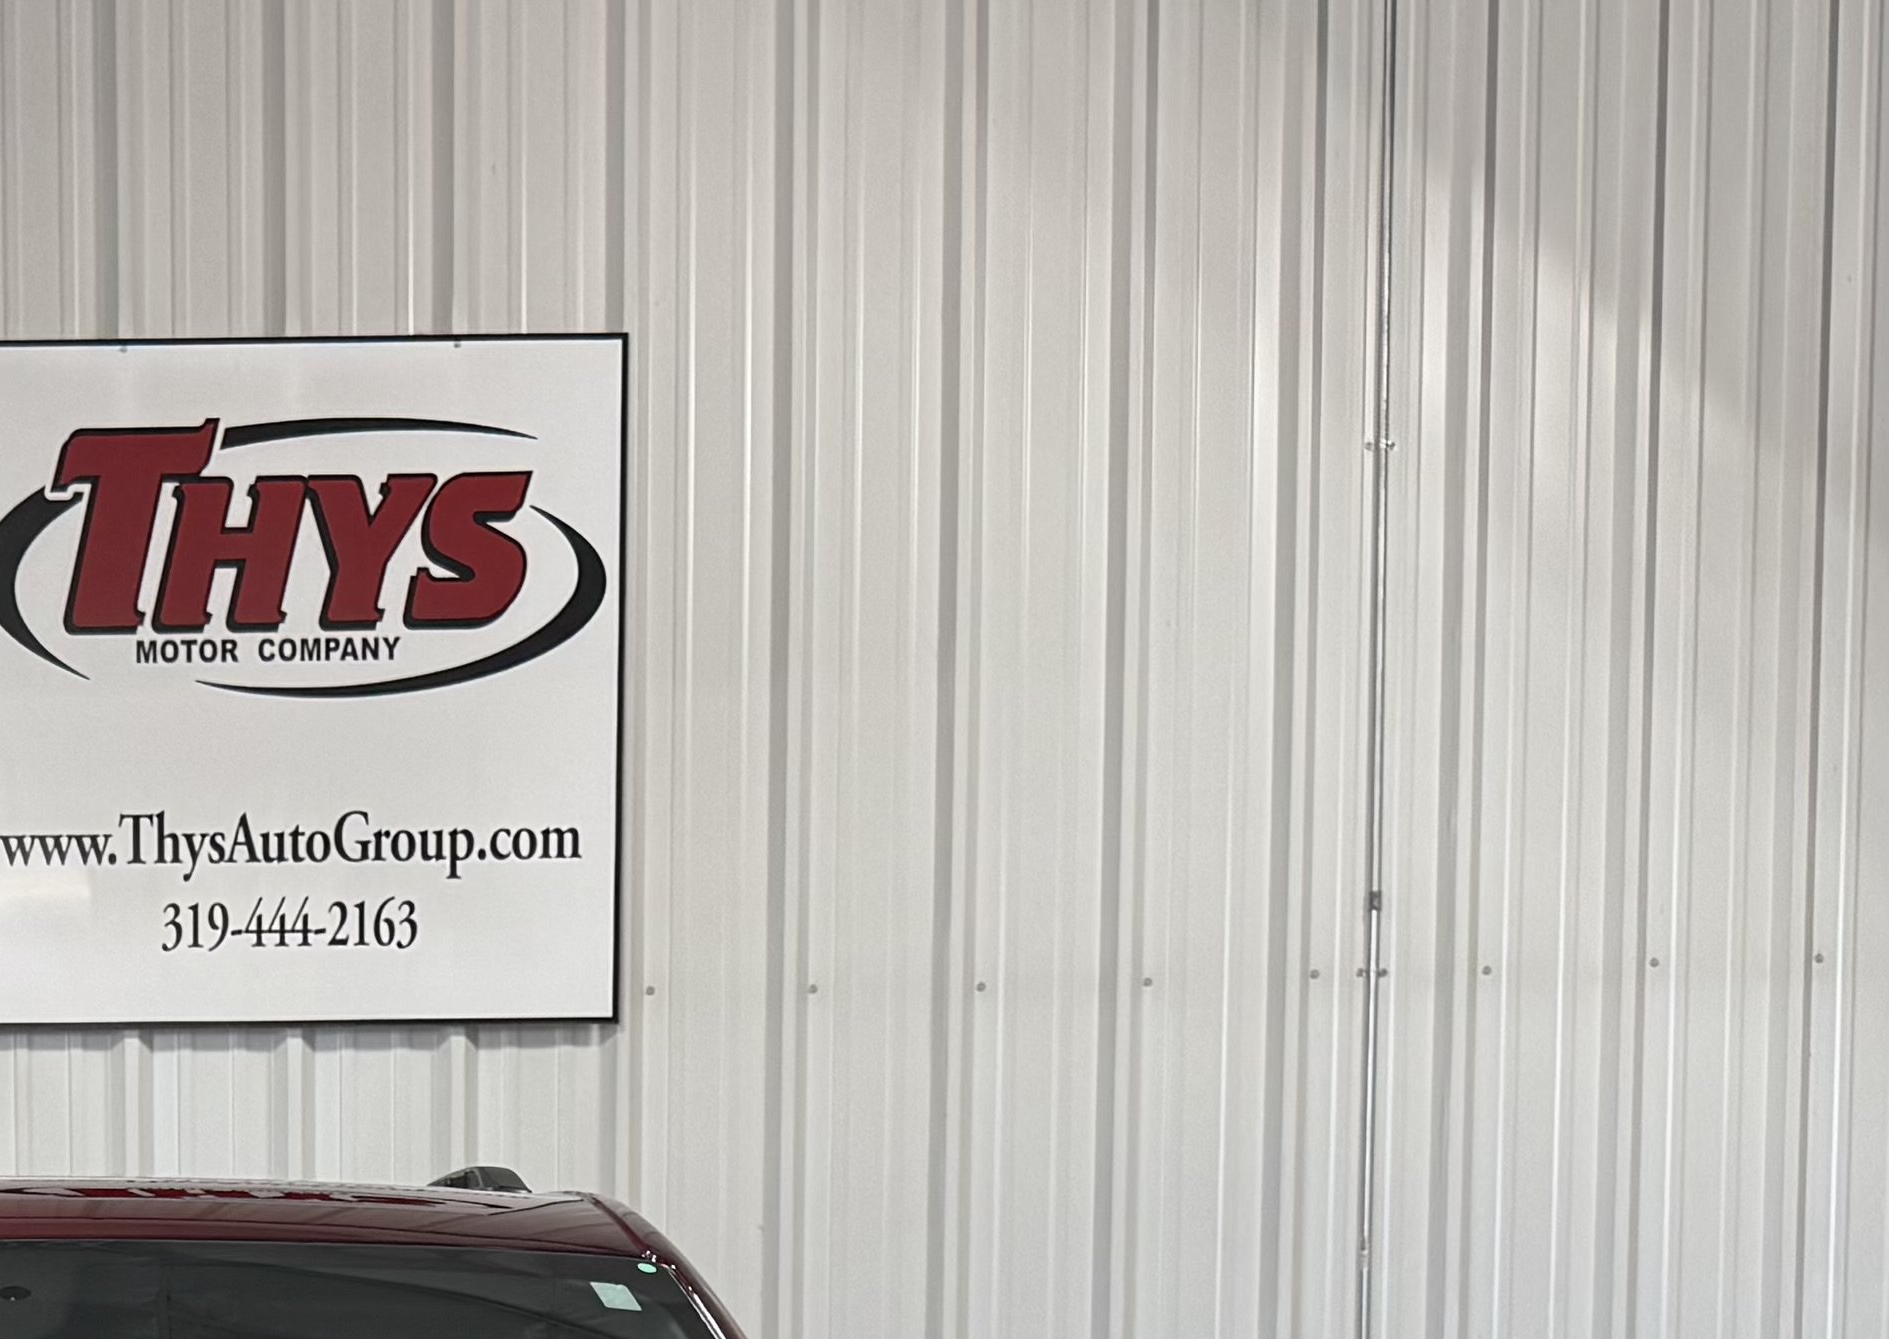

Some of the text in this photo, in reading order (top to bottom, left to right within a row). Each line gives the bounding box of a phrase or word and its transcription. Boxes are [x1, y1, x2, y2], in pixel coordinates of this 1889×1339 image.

[50, 417, 533, 635] THYS
[135, 636, 400, 664] MOTOR COMPANY
[0, 811, 583, 881] www.ThysAutoGroup.com
[161, 897, 419, 952] 319-444-2163
